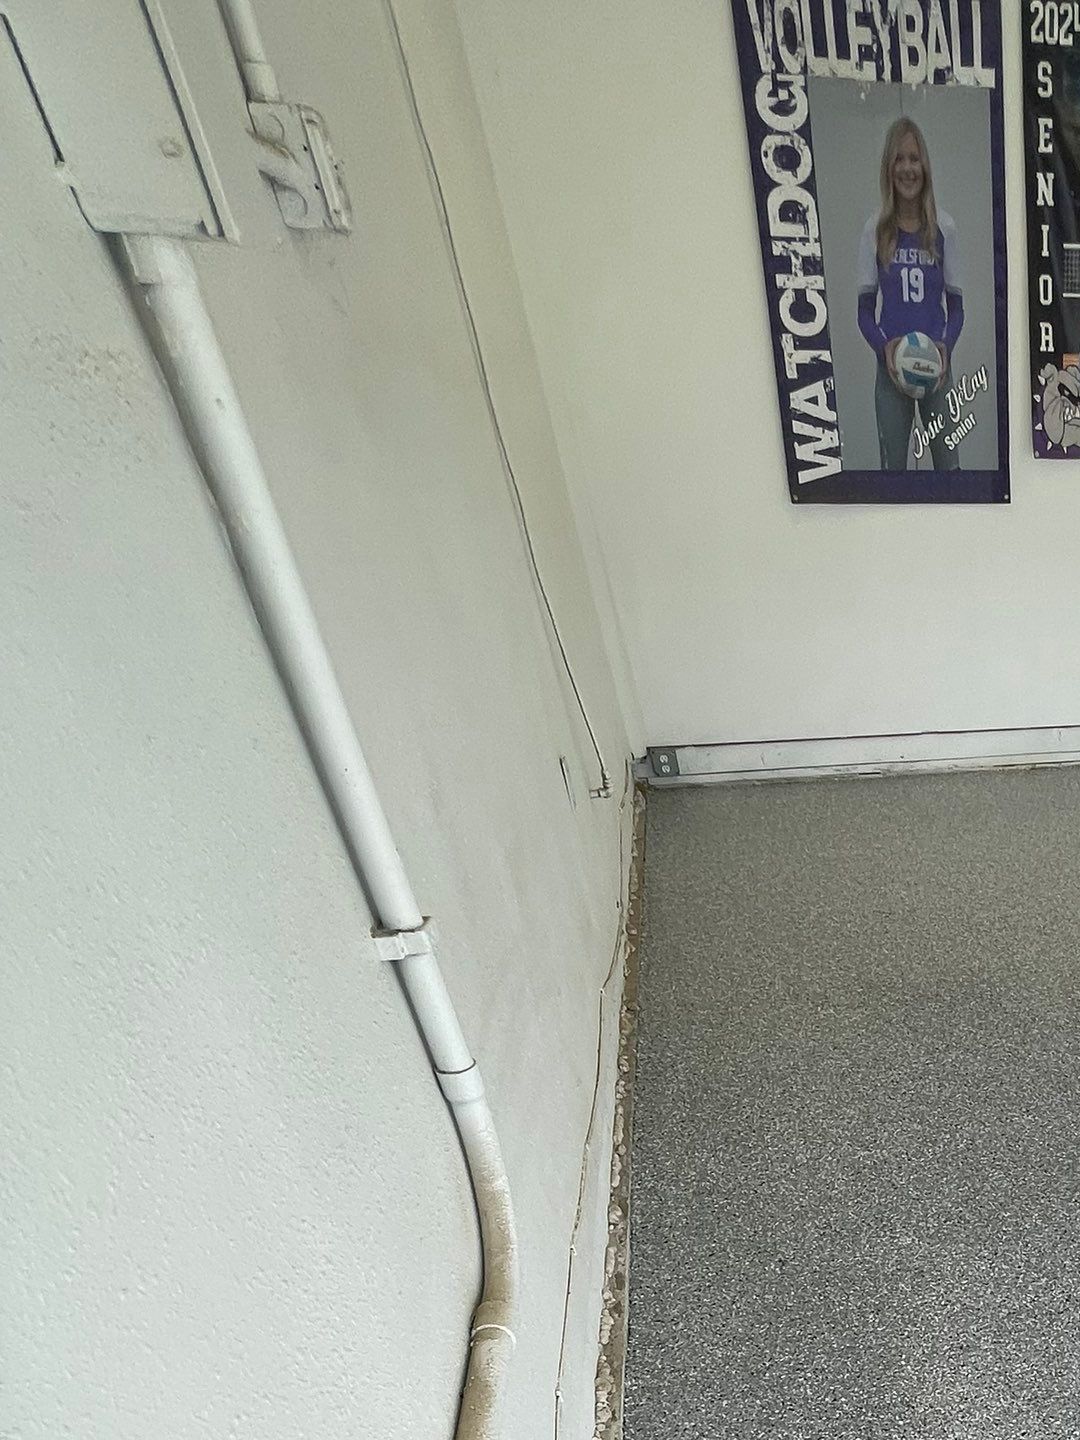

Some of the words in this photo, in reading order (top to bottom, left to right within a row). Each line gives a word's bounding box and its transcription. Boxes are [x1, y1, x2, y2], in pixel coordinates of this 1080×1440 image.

[746, 0, 996, 88] VOLLEYBALL
[1036, 60, 1055, 352] SENIOR
[755, 72, 843, 485] WATCHDOG
[901, 267, 924, 303] 19
[914, 412, 945, 459] Josie
[944, 413, 977, 451] Senior
